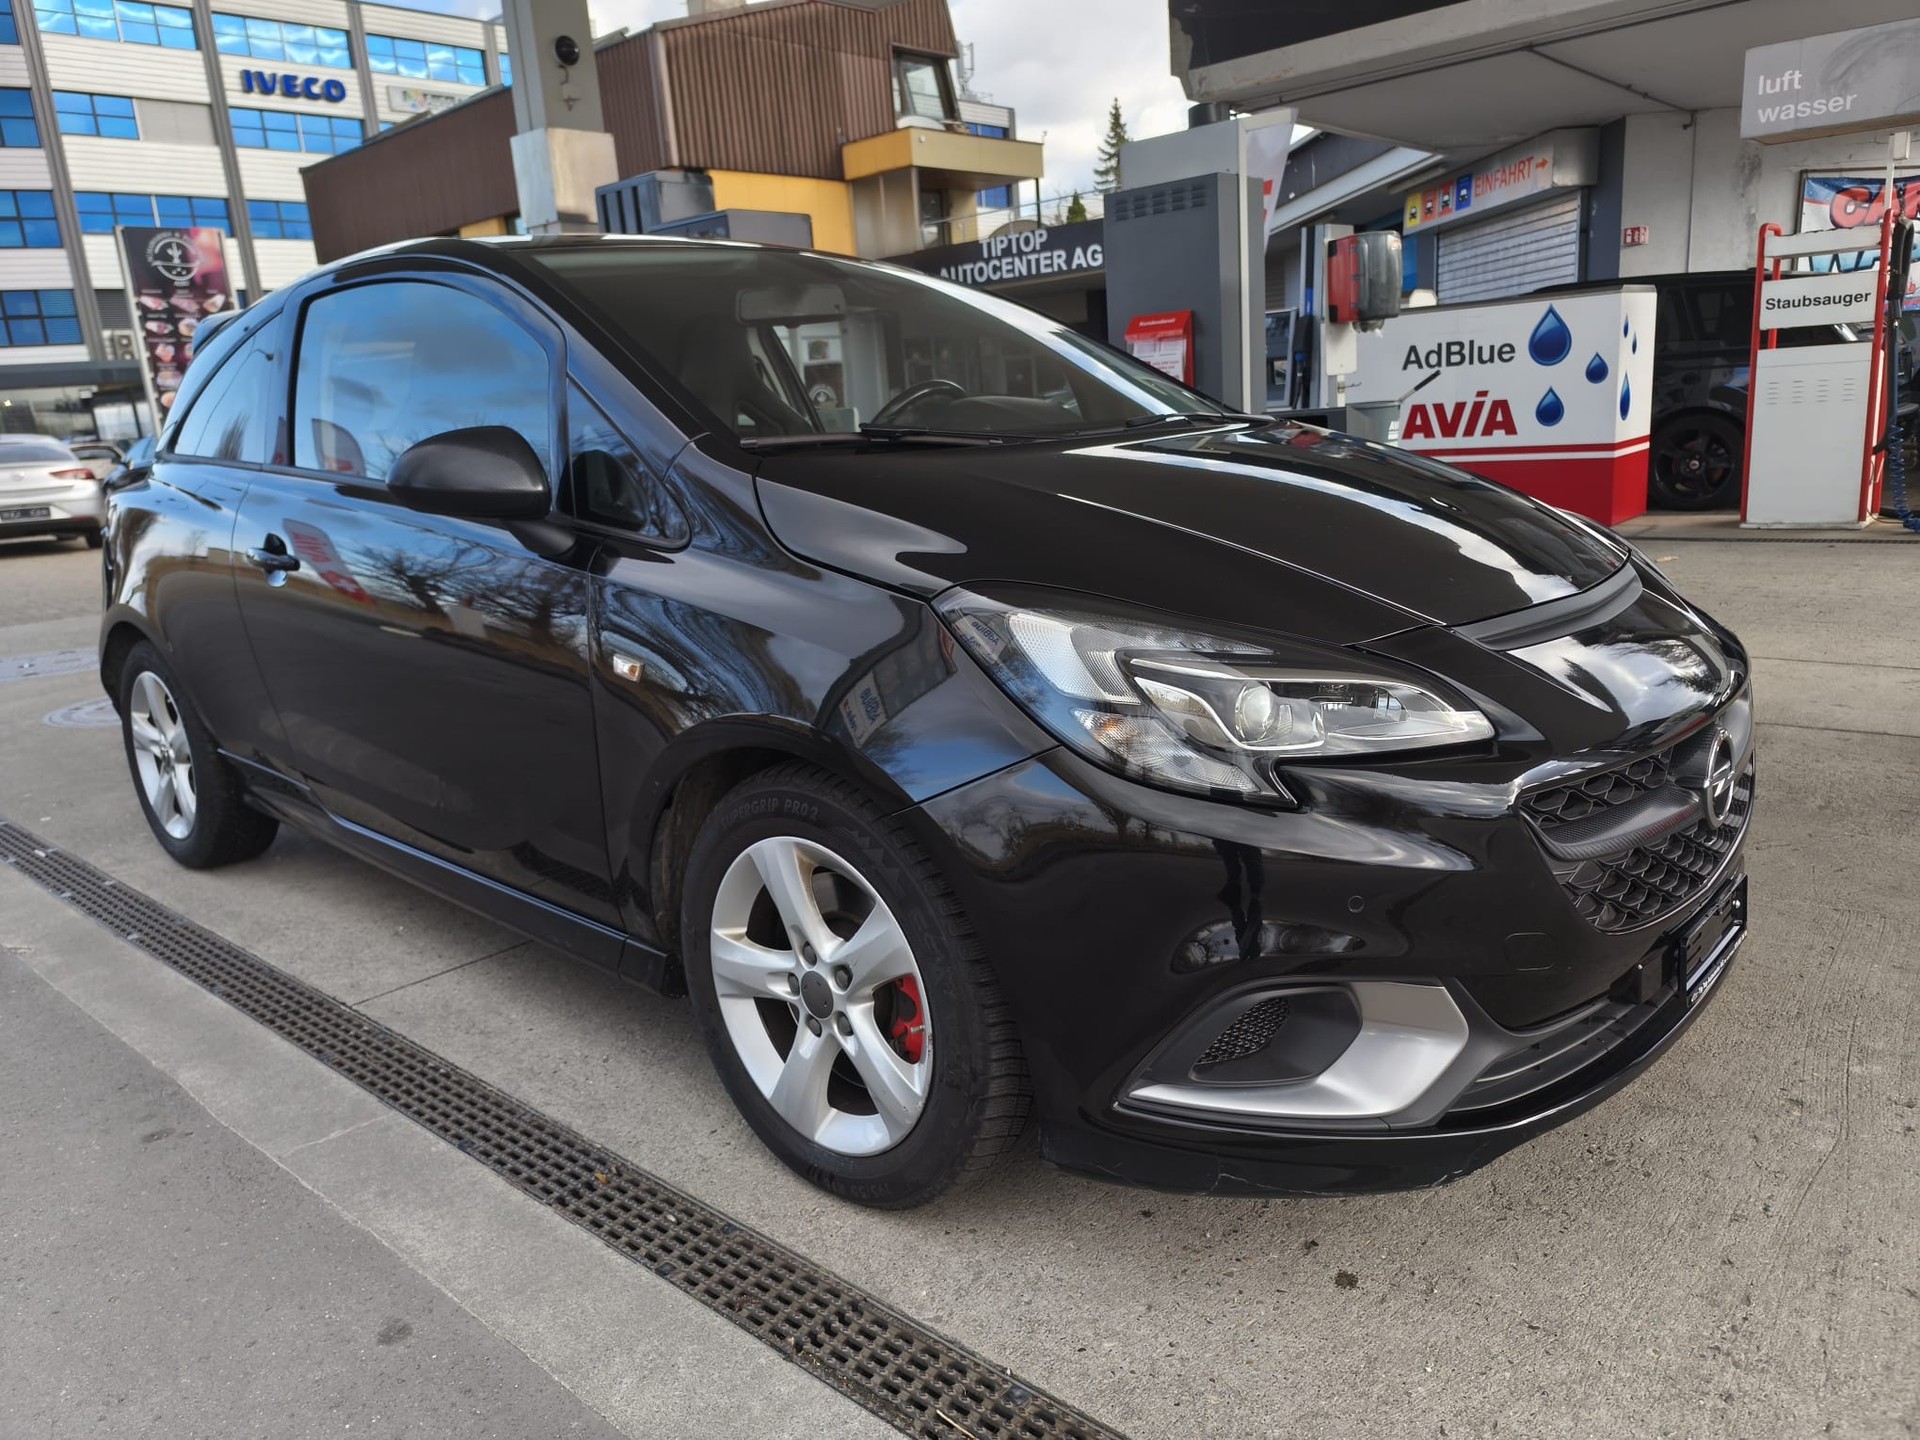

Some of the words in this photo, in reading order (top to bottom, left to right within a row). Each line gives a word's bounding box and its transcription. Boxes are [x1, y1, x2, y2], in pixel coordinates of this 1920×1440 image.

[241, 69, 347, 103] IVECO
[1758, 69, 1802, 95] luft
[1757, 94, 1858, 123] wasser
[1474, 156, 1536, 198] EINFAHRT
[979, 229, 1048, 259] TIPTOP
[1071, 243, 1104, 270] AG
[1765, 291, 1872, 311] Staubsauger
[1402, 340, 1516, 371] AdBlue
